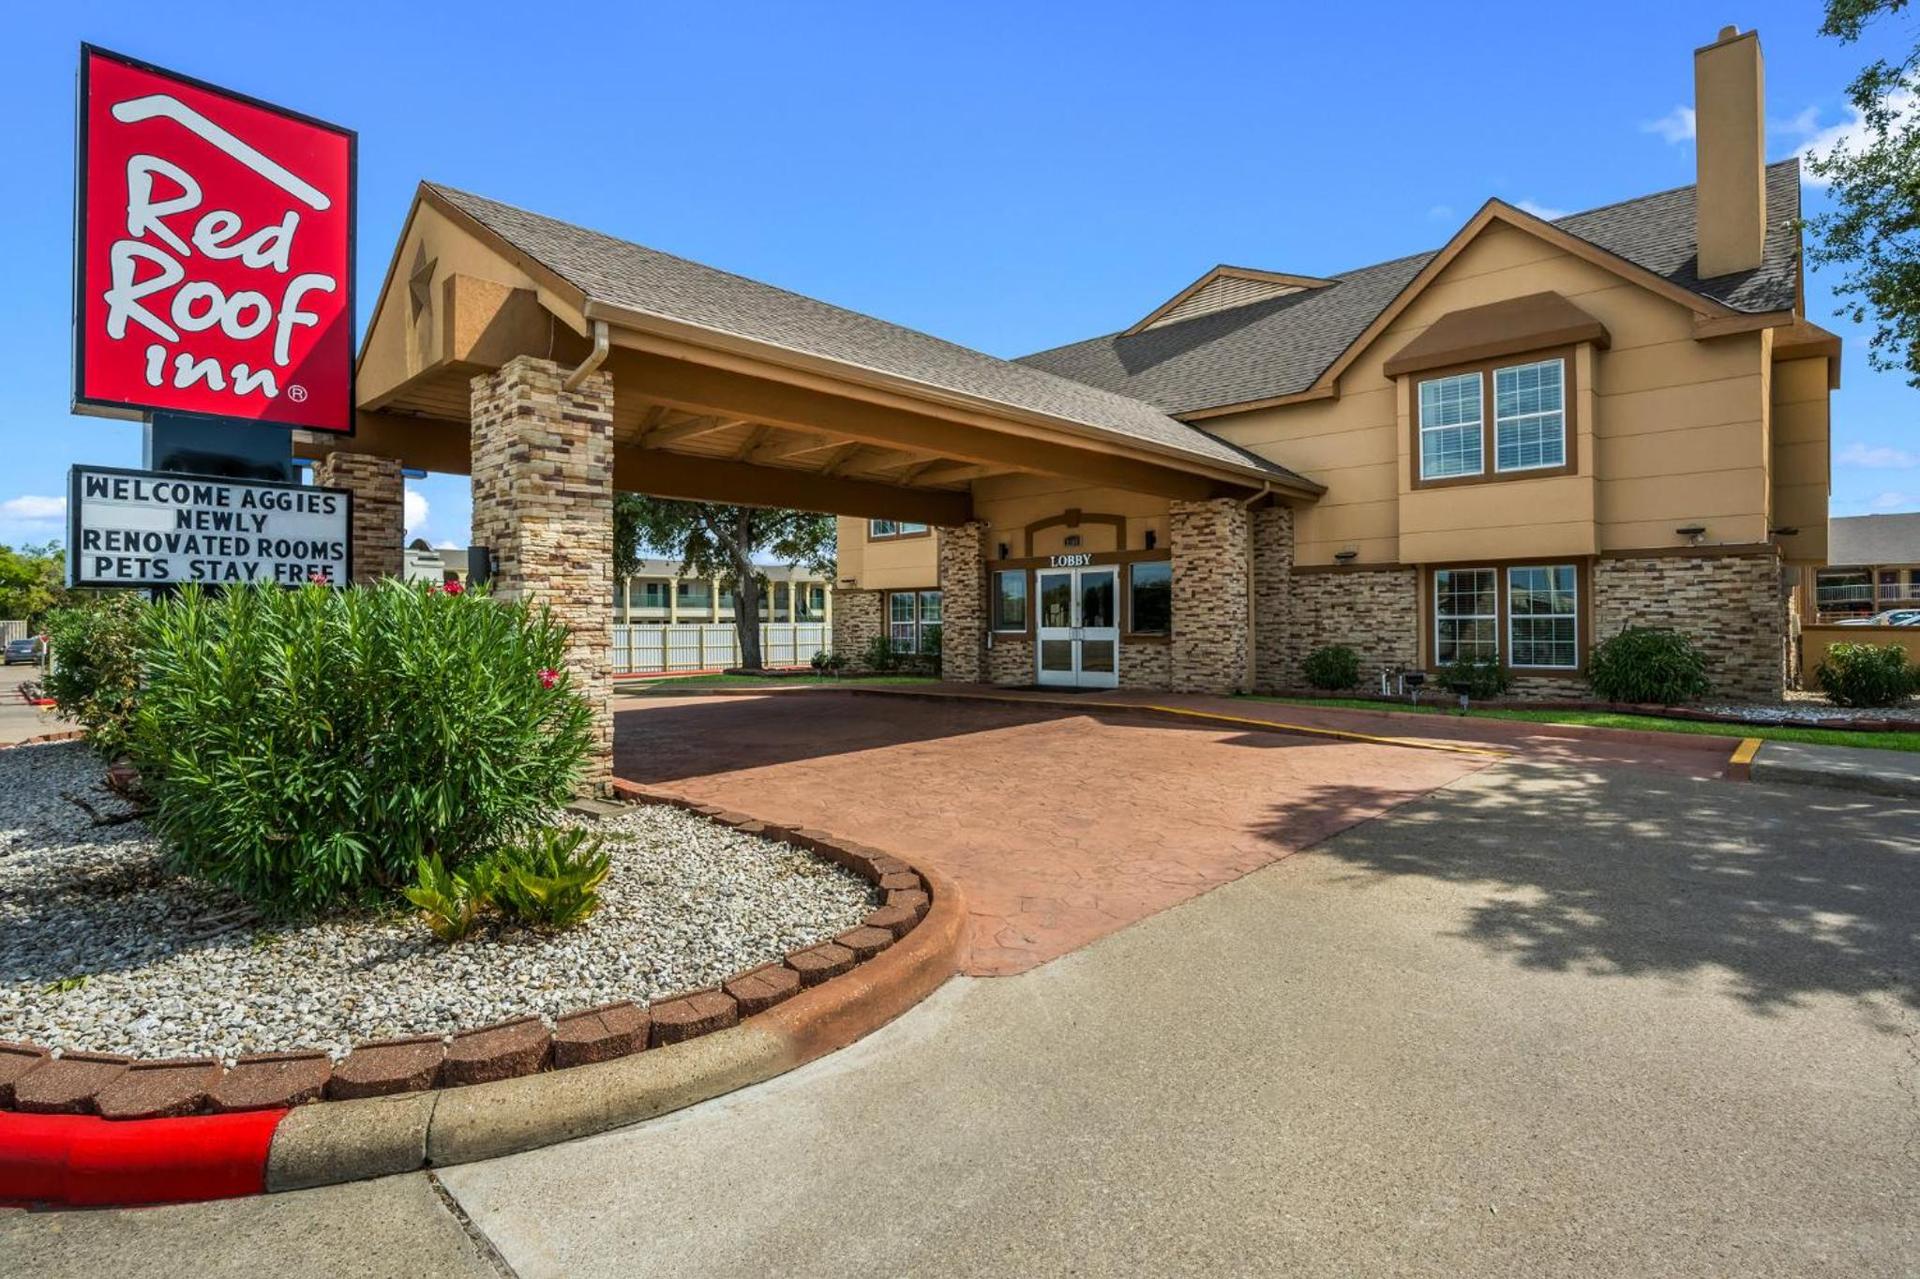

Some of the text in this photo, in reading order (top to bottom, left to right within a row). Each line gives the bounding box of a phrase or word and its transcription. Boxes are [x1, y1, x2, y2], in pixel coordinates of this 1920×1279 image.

[127, 154, 300, 273] Red
[103, 240, 336, 367] Roof
[86, 476, 337, 514] WELCOME AGGIES
[176, 509, 269, 533] NEWLY
[83, 529, 344, 561] RENOVATED ROOMS
[1050, 553, 1092, 568] LOBBY
[95, 556, 334, 583] PETS STAY FREE
